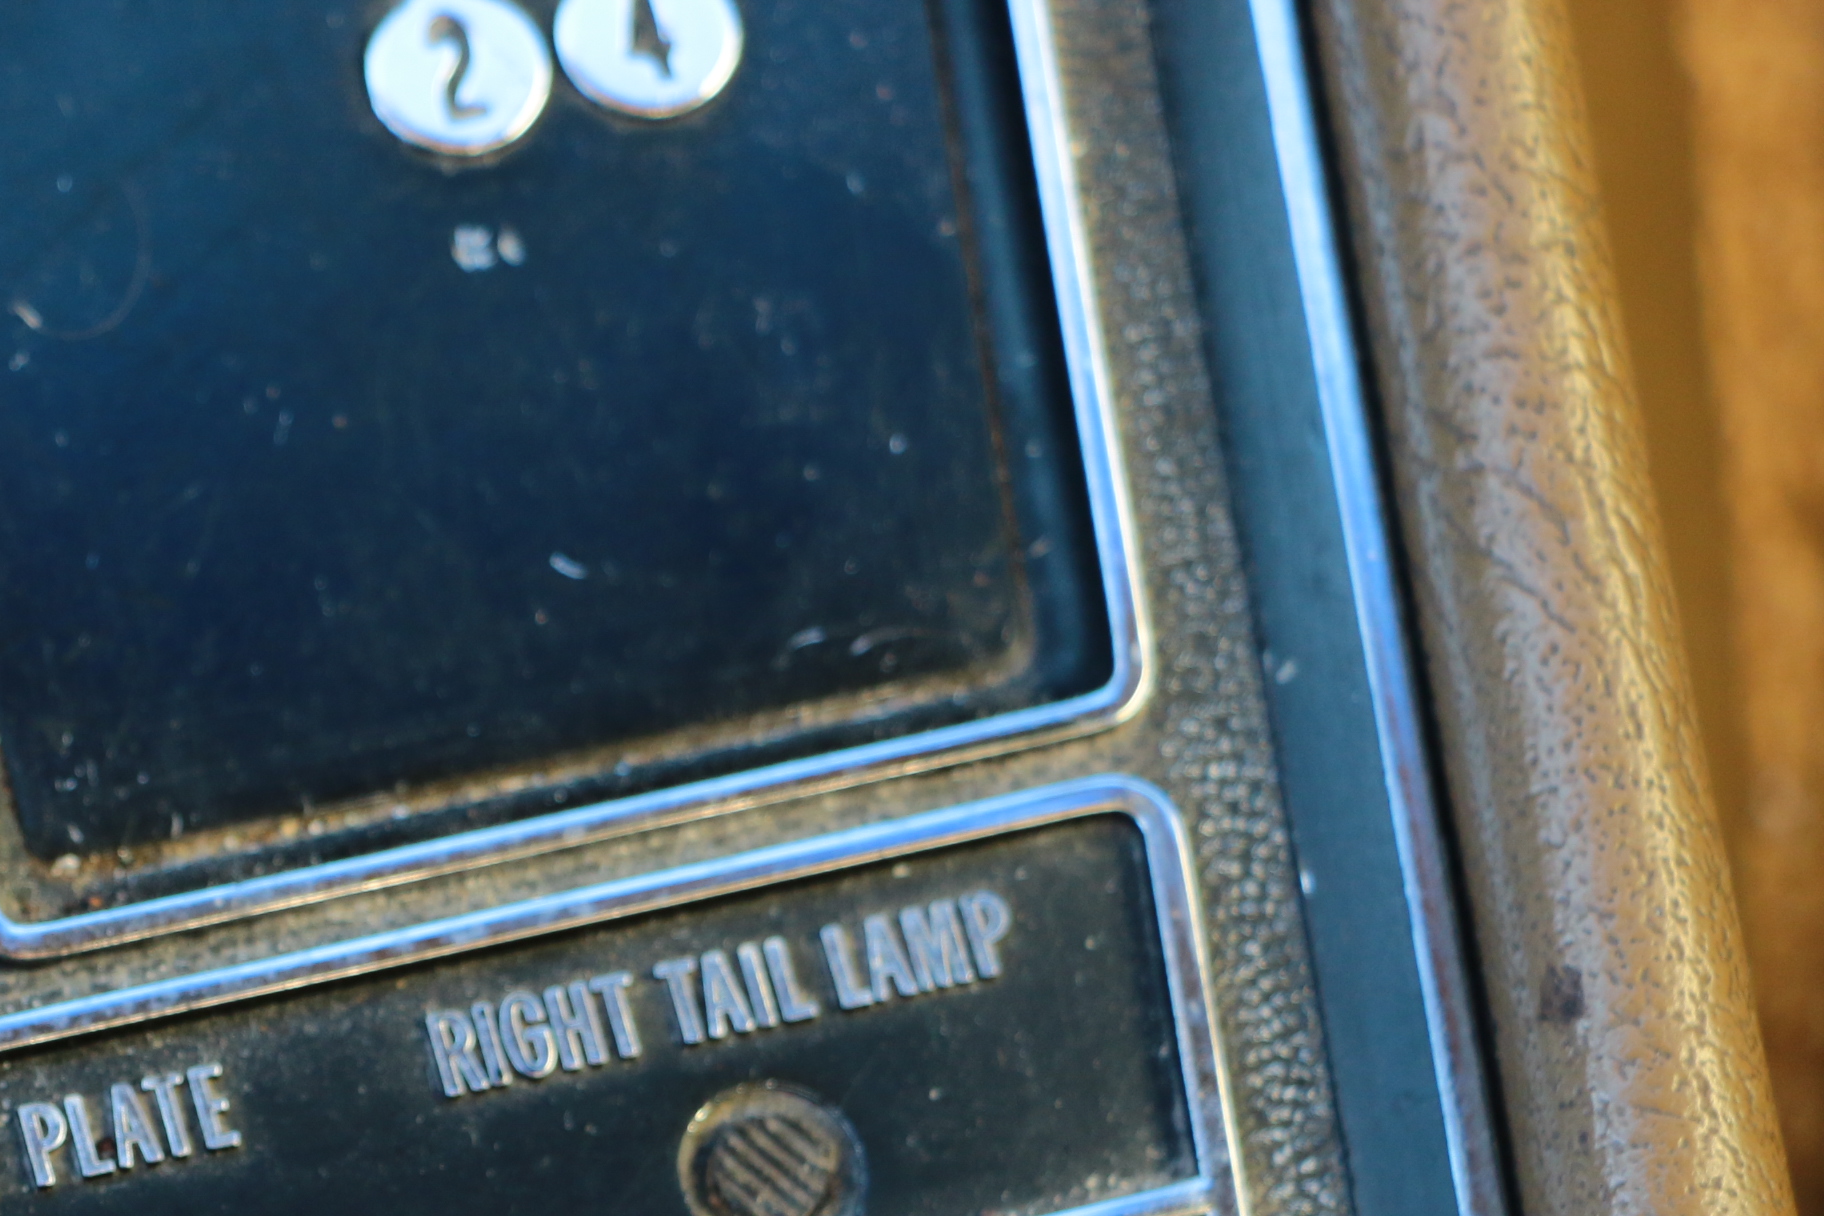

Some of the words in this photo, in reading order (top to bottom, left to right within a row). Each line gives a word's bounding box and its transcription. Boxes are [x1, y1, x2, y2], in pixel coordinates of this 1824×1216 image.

[427, 14, 488, 121] 2
[425, 971, 642, 1098] RIGHT
[653, 936, 819, 1045] TAIL
[819, 890, 1012, 1010] LAMP
[17, 1064, 242, 1188] PLATE
